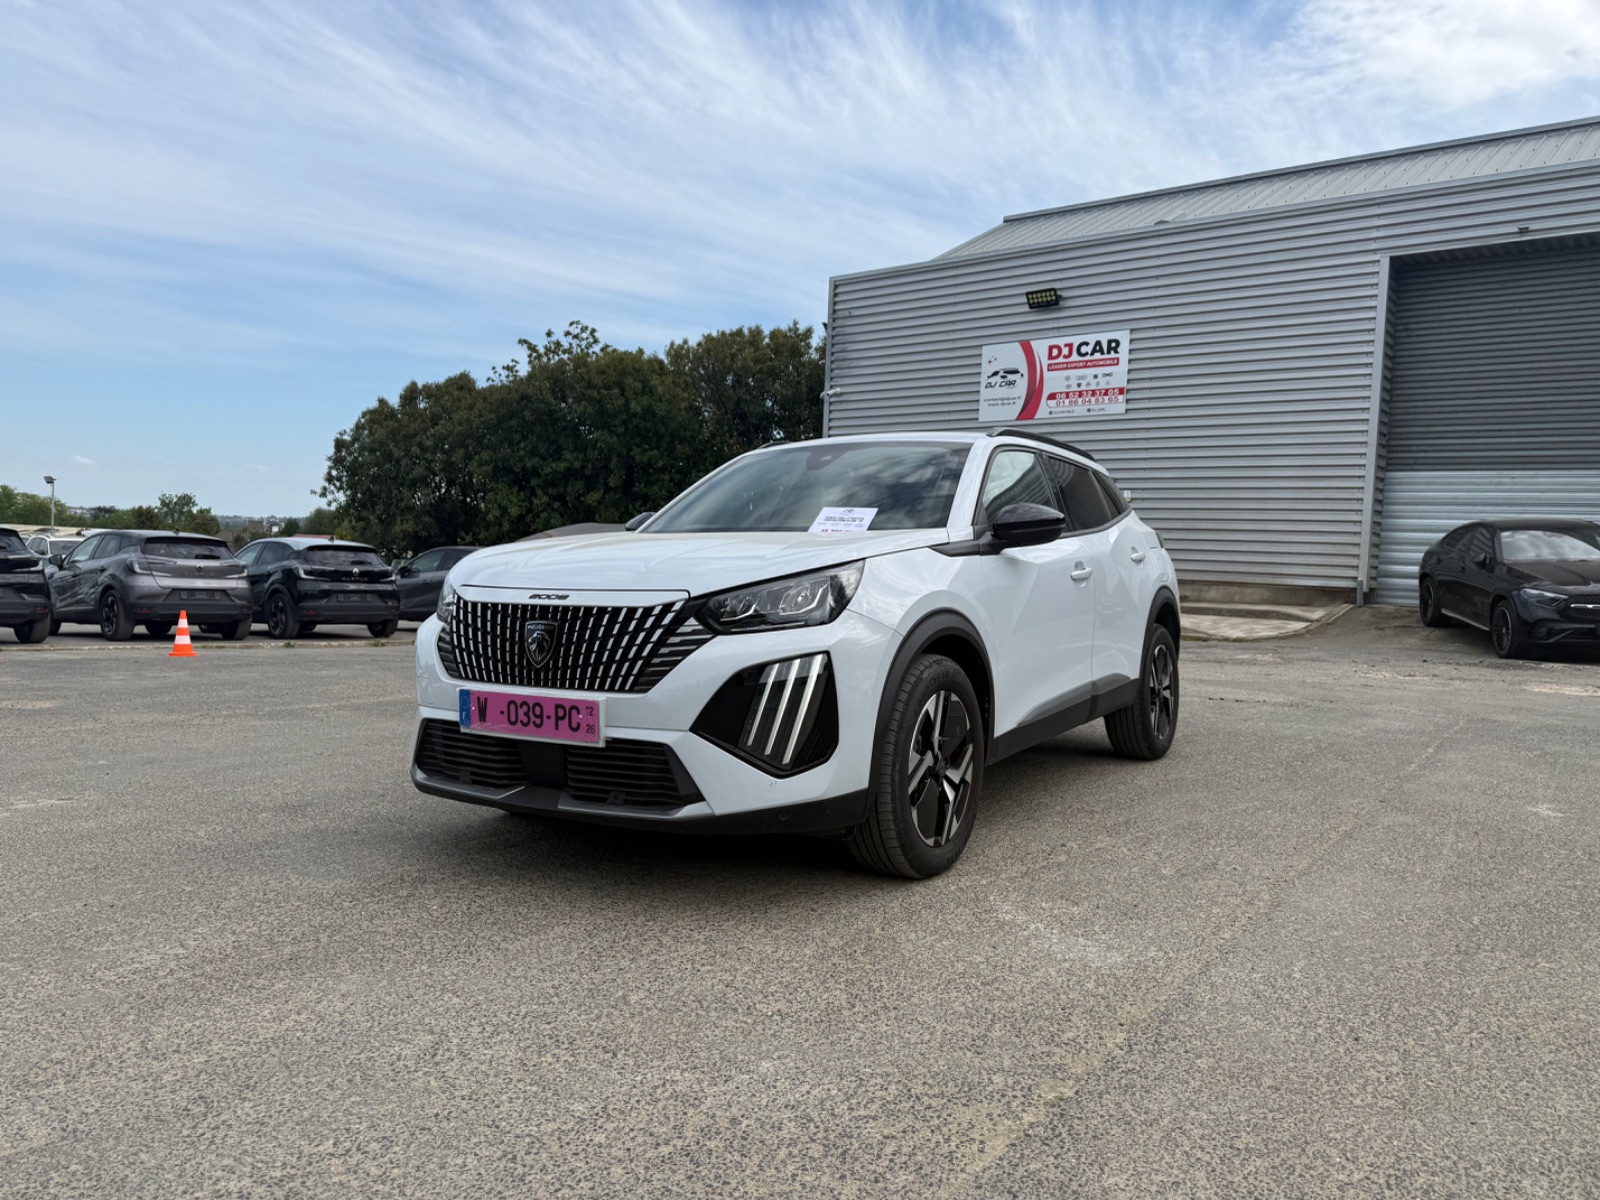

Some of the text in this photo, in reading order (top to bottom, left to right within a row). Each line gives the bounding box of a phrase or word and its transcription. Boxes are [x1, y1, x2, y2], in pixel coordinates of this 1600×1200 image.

[1047, 338, 1121, 361] DJ CAR
[1087, 359, 1118, 367] AUTOMOBILE
[985, 380, 1017, 389] DJ CAR
[1056, 399, 1066, 407] 01
[586, 724, 595, 734] 26
